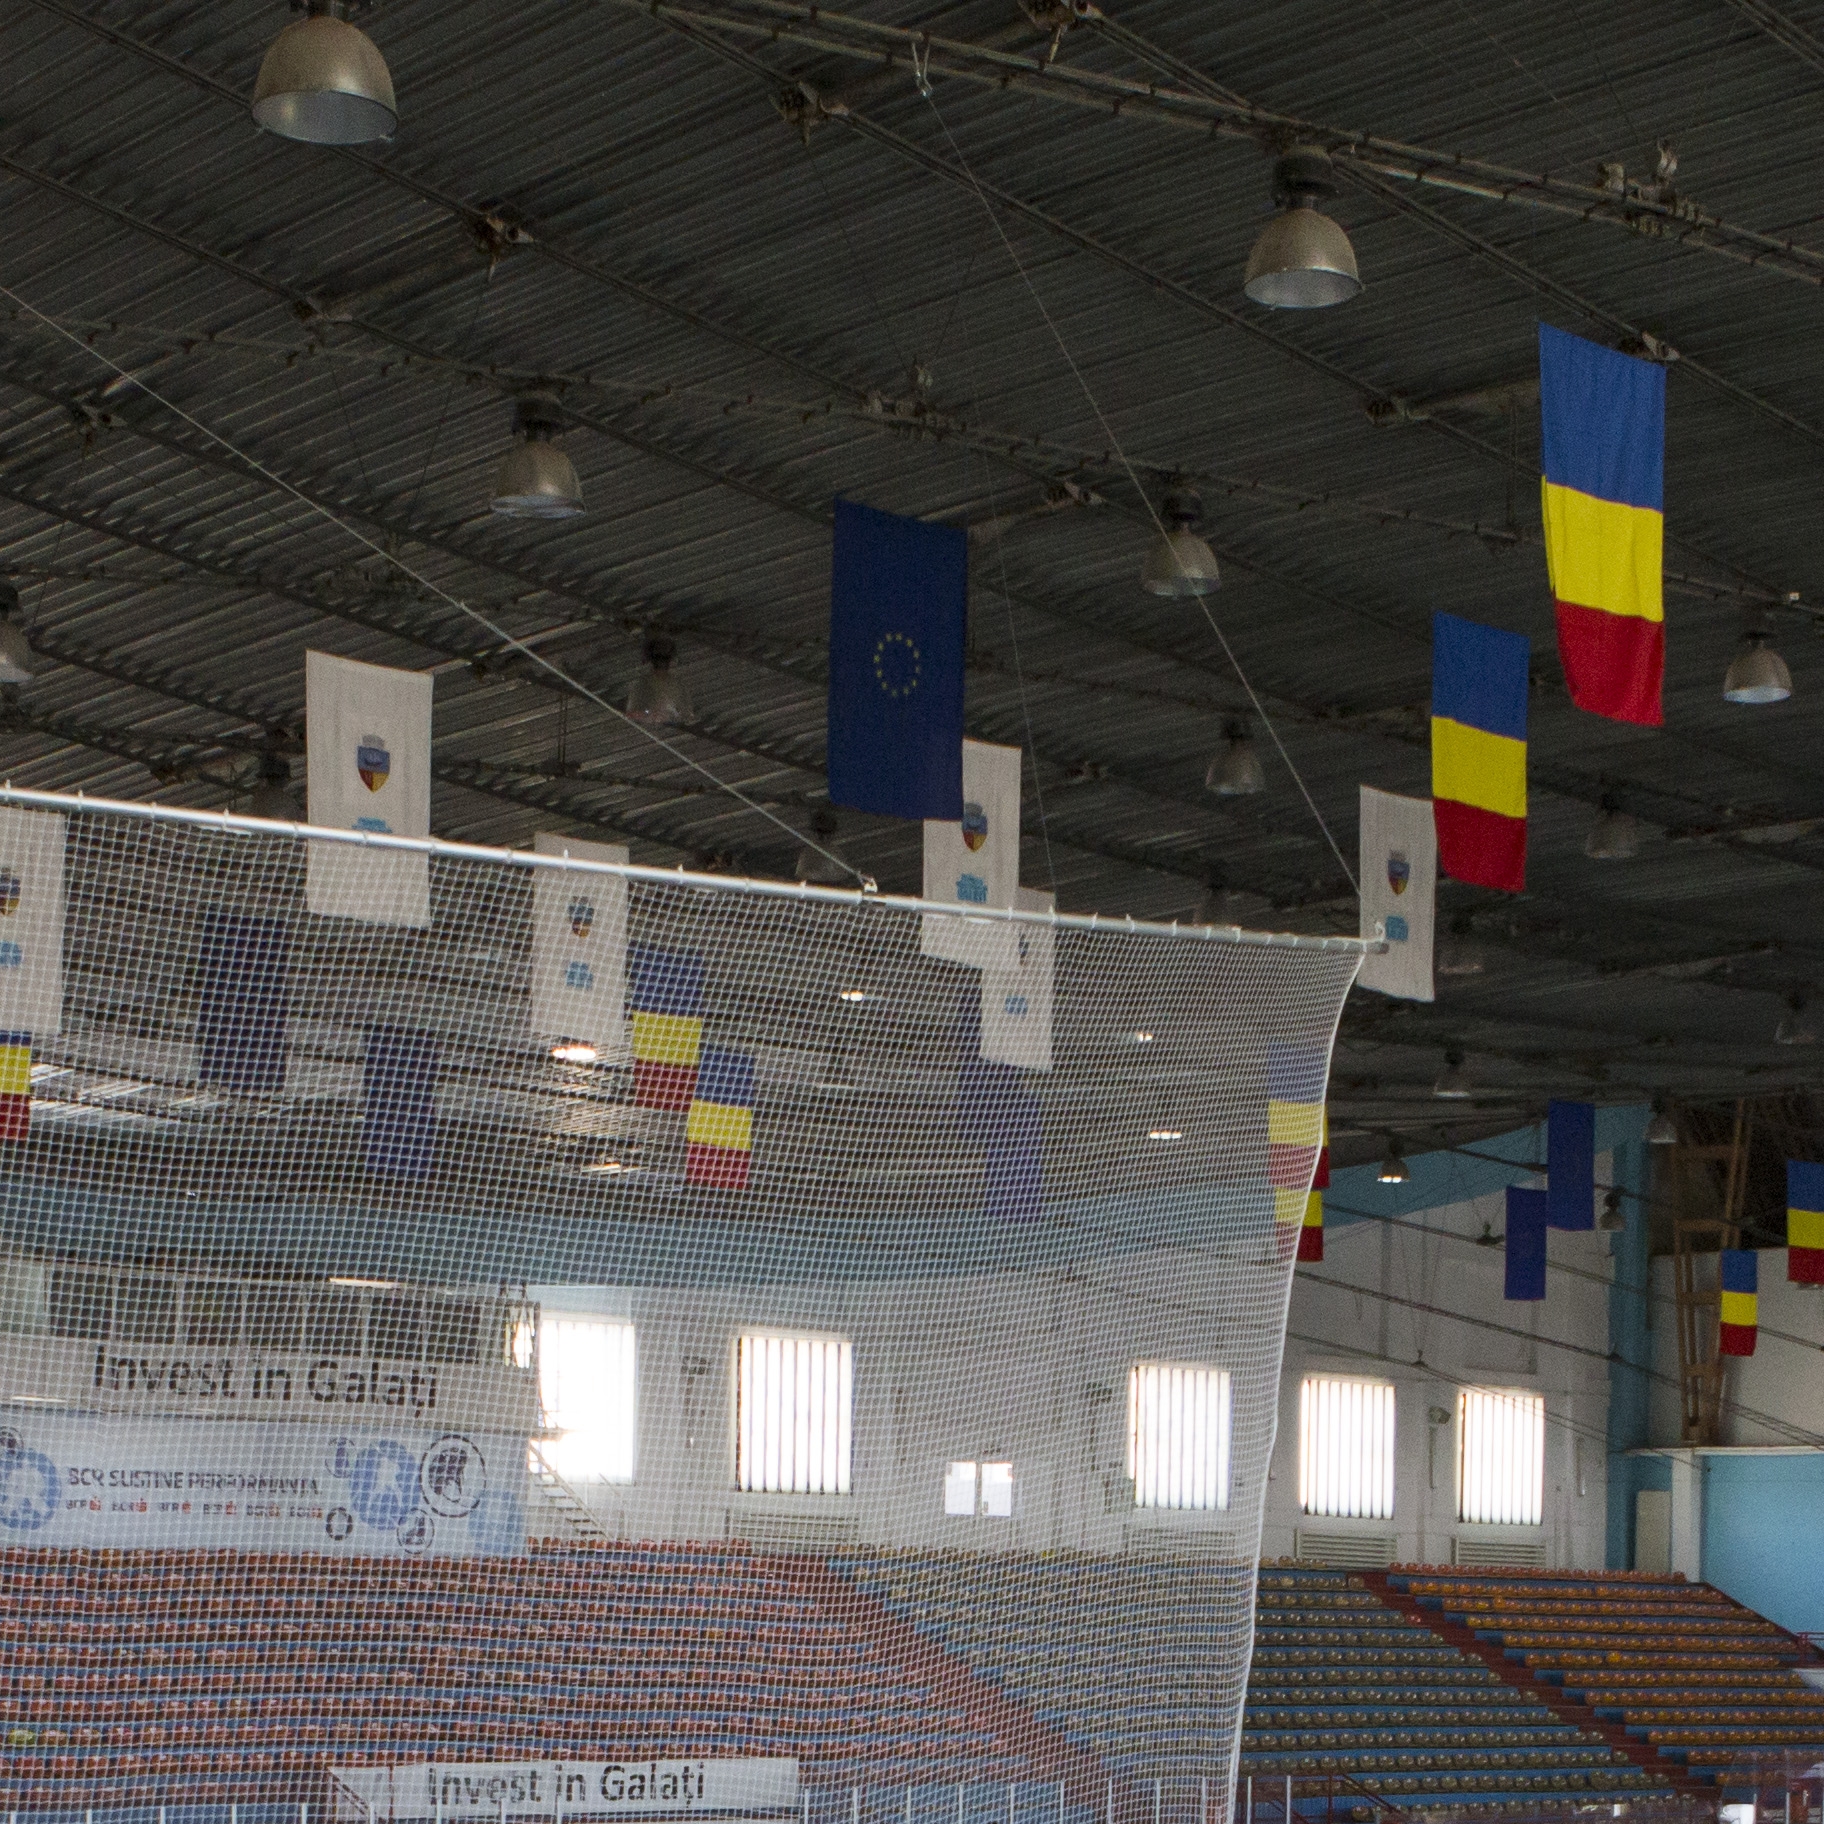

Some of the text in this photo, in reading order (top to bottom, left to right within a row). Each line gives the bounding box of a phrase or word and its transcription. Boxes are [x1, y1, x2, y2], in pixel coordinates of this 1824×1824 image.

[95, 1346, 236, 1398] Invest
[253, 1355, 291, 1400] in
[429, 1767, 542, 1805] Invest
[555, 1764, 586, 1802] in
